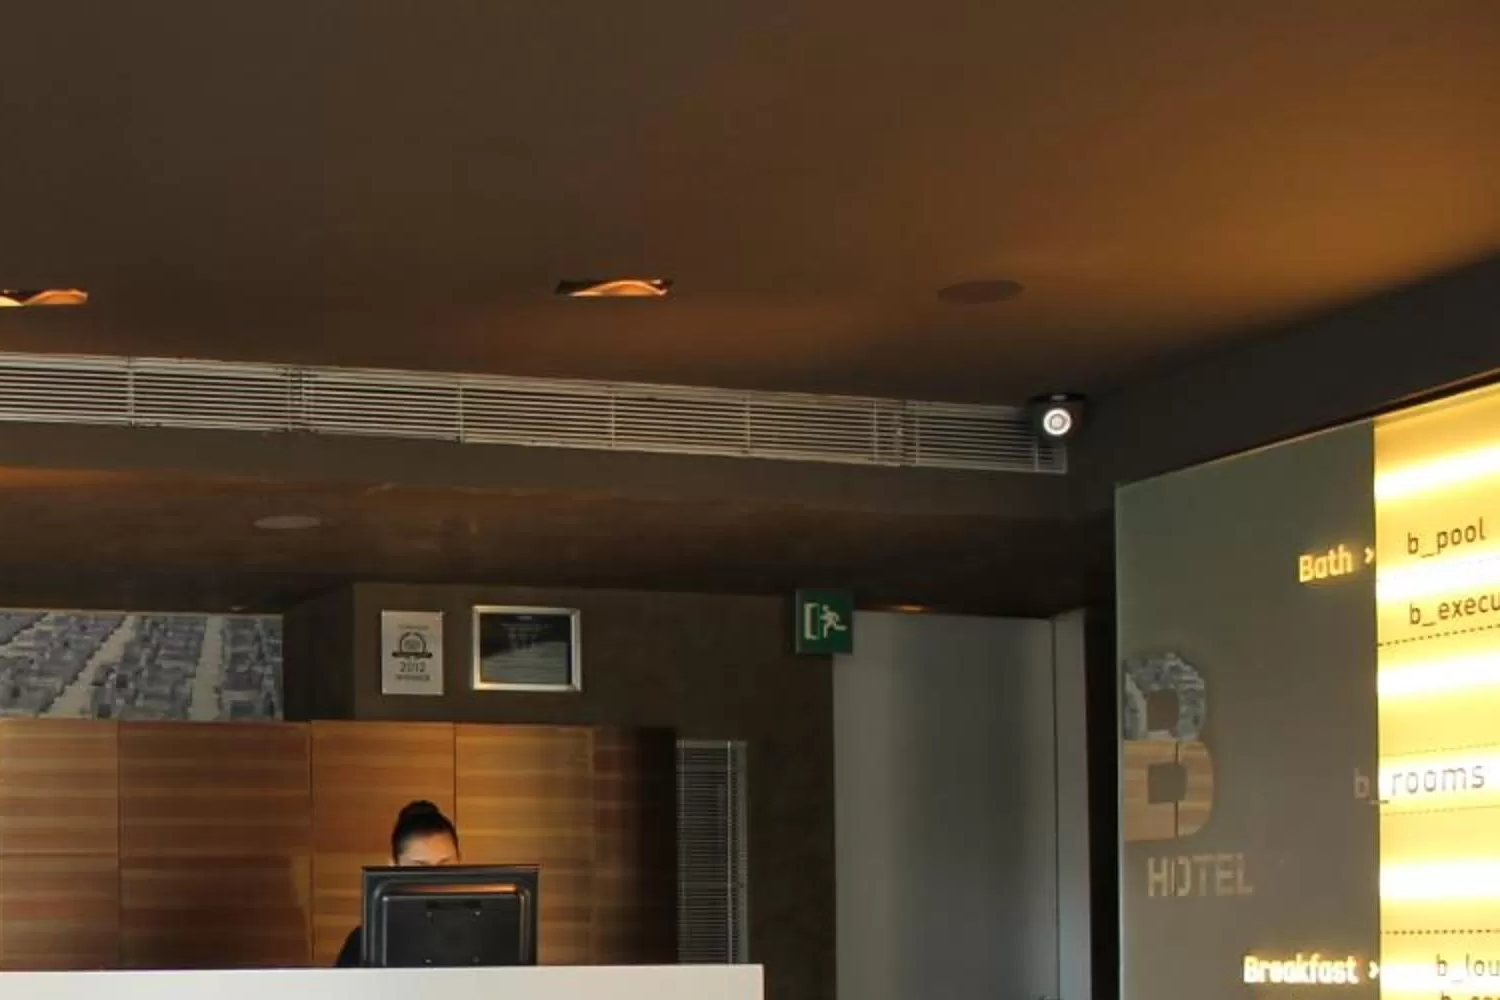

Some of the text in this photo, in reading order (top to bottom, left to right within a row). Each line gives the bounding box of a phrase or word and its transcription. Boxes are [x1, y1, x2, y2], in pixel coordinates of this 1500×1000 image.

[1298, 516, 1486, 582] Bath b_pool
[1353, 765, 1485, 804] b_rooms
[1147, 853, 1253, 897] HOTEL
[1243, 953, 1359, 985] Breakfast
